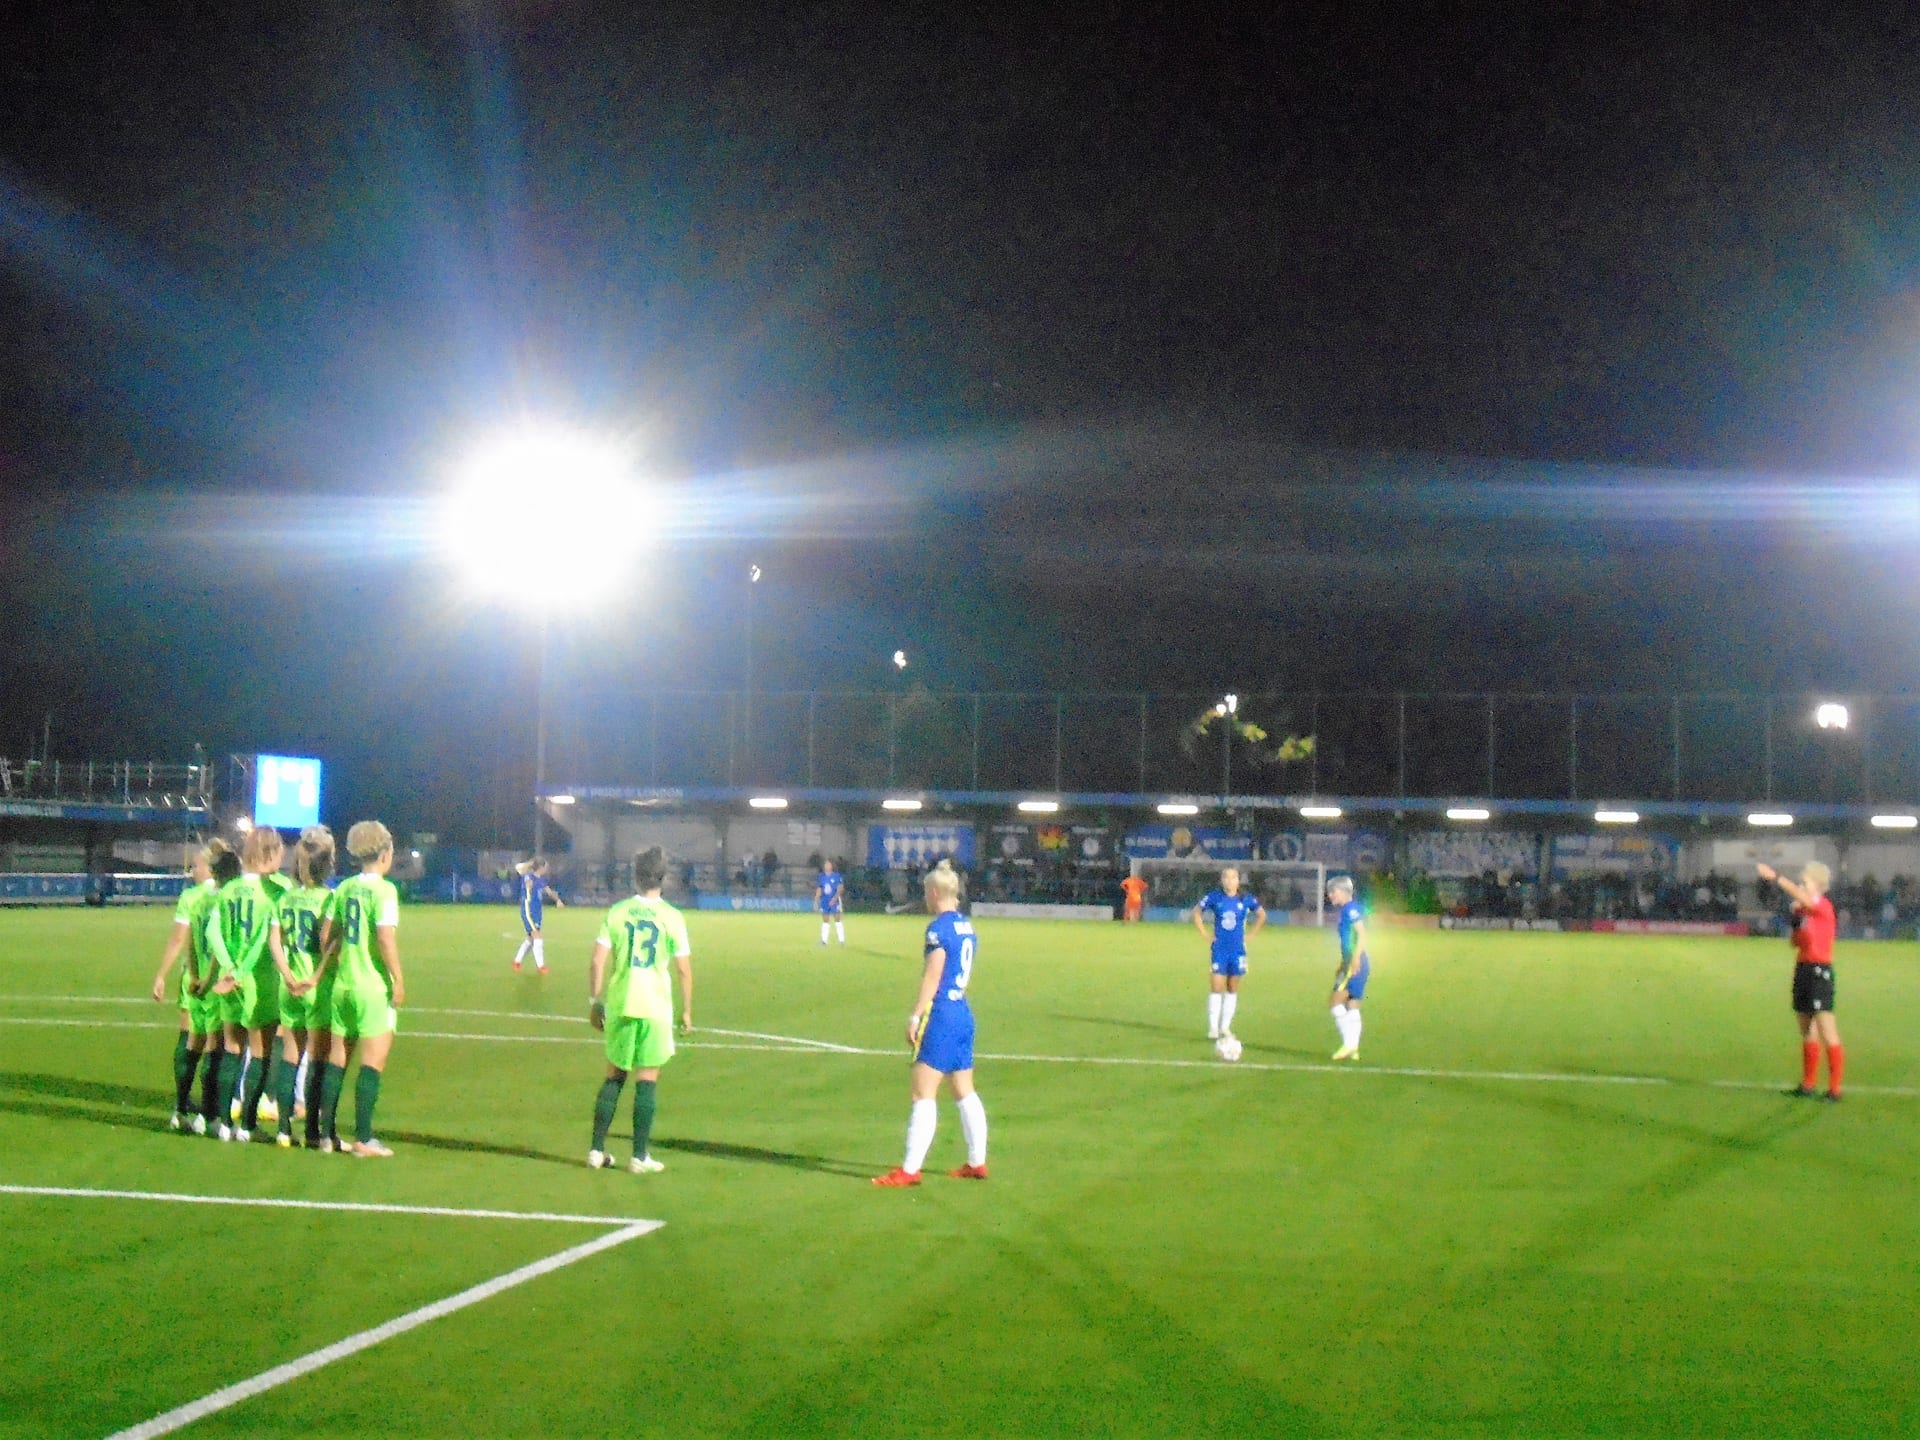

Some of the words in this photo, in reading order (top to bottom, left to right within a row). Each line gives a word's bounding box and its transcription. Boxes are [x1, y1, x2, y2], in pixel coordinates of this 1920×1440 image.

[345, 897, 361, 946] 8
[624, 919, 660, 968] 13
[955, 937, 973, 989] 9
